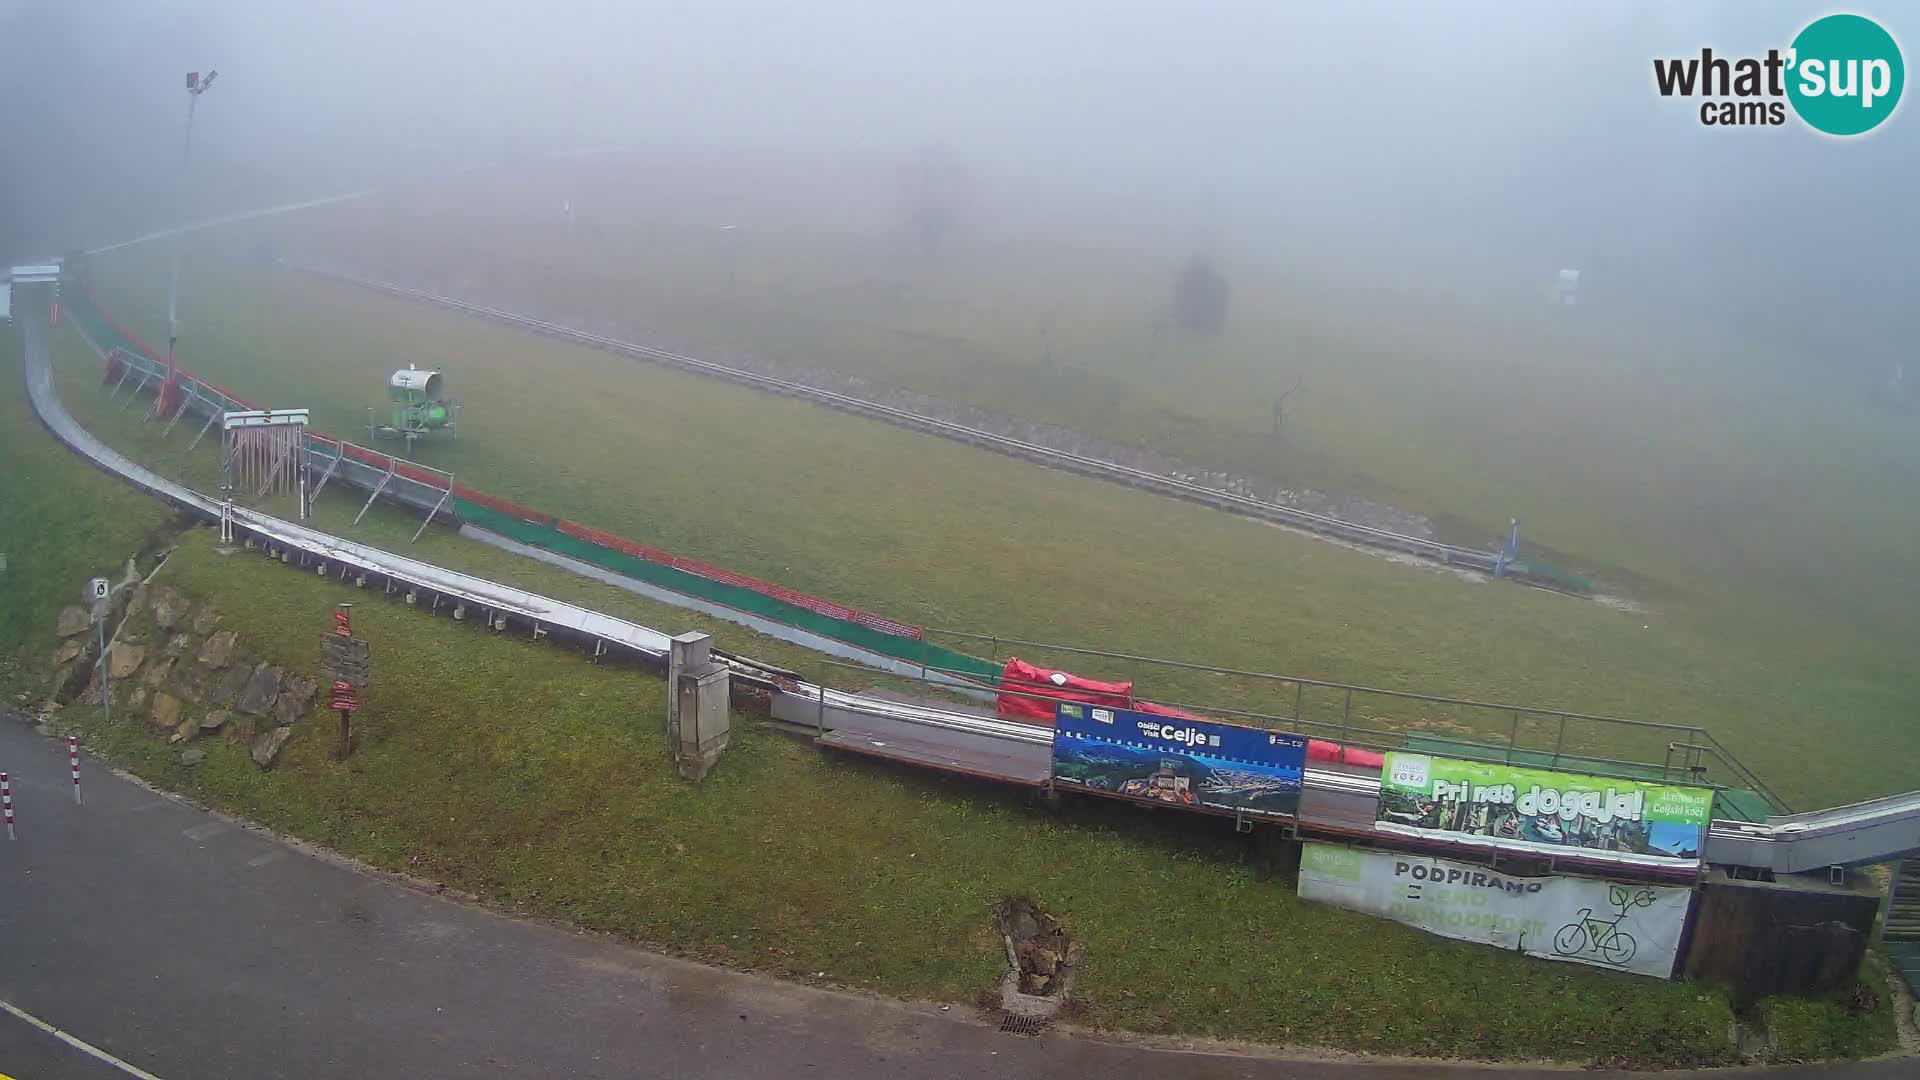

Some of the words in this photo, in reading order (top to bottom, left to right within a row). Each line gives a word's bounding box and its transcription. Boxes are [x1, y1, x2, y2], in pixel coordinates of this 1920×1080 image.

[1161, 725, 1207, 747] Celje
[1432, 779, 1469, 802] Pri
[1472, 783, 1515, 804] nas
[1653, 803, 1683, 816] Celjski
[1395, 862, 1542, 893] PODPIRAMO
